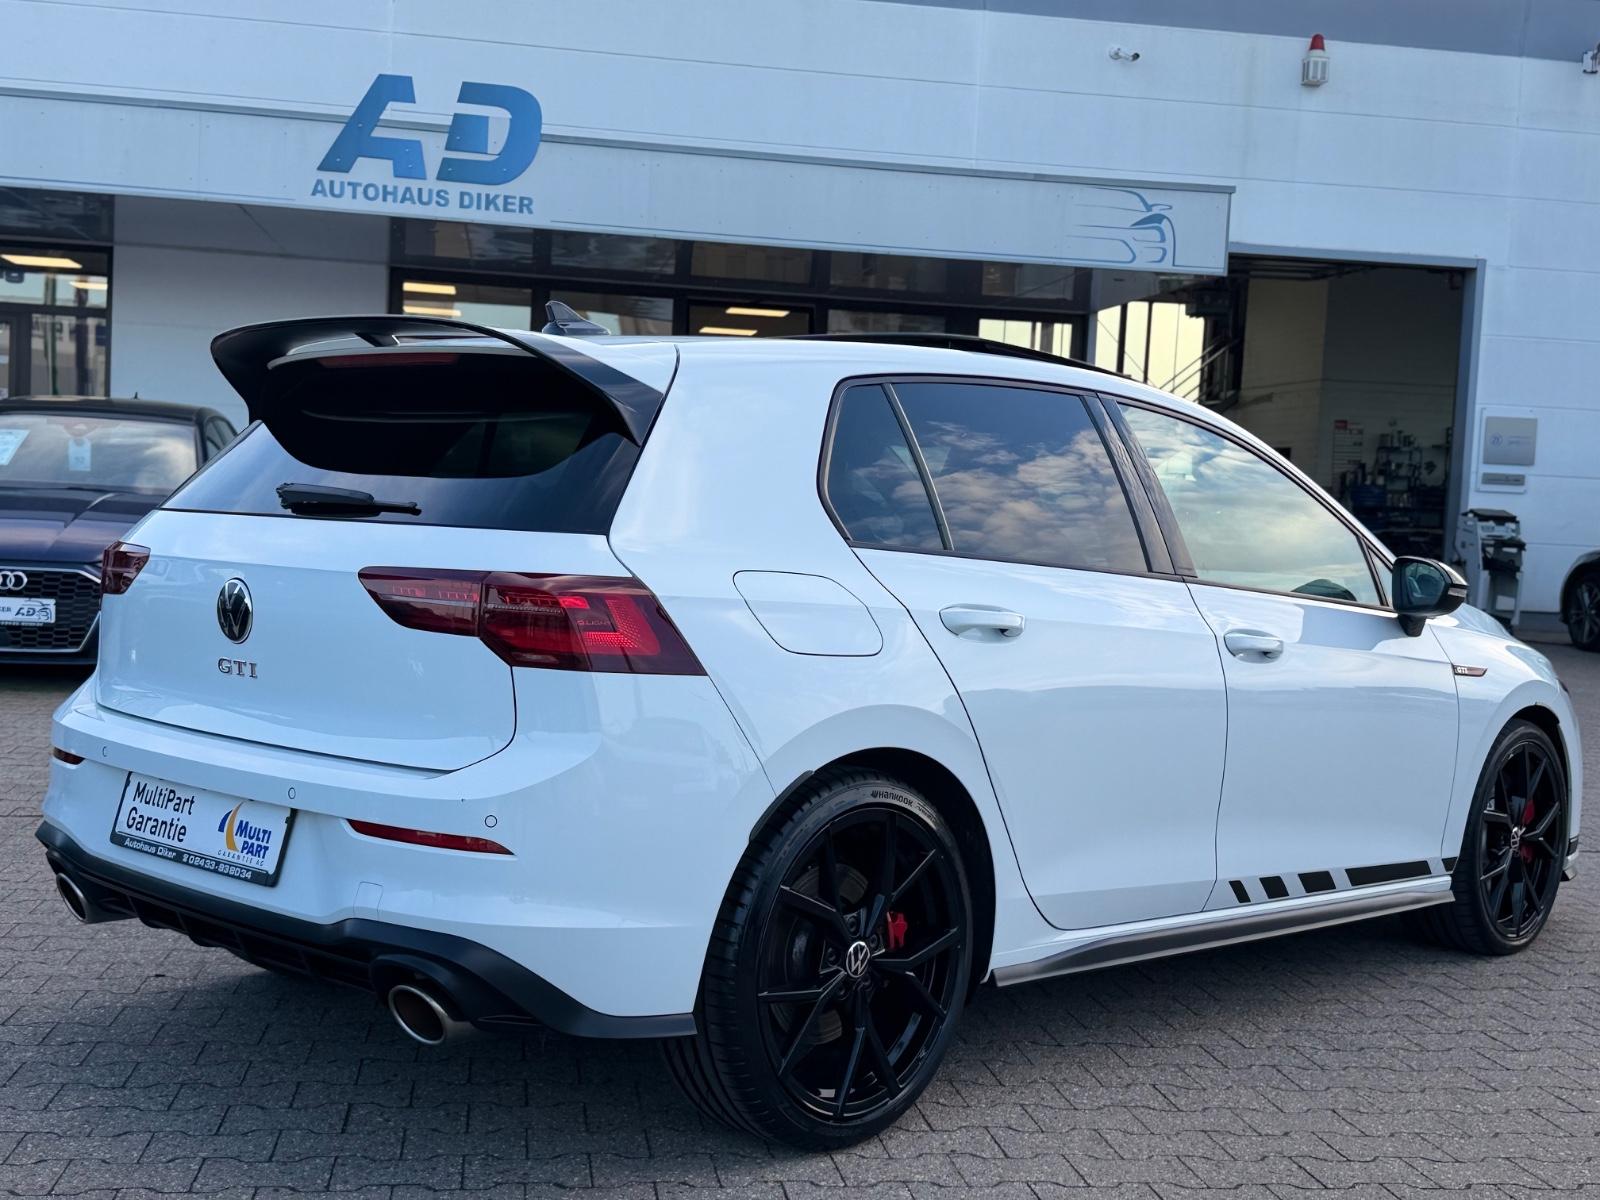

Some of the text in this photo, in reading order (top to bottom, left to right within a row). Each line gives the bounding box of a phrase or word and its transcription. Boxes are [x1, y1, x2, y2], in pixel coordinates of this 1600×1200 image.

[310, 178, 534, 215] AUTOHAUS DIKER
[218, 657, 258, 679] GTI
[132, 781, 195, 816] MultiPart
[126, 806, 187, 843] Garantie
[235, 819, 272, 844] MULTI
[124, 837, 156, 854] Autohaus
[156, 847, 177, 859] Diker
[240, 843, 270, 859] PART
